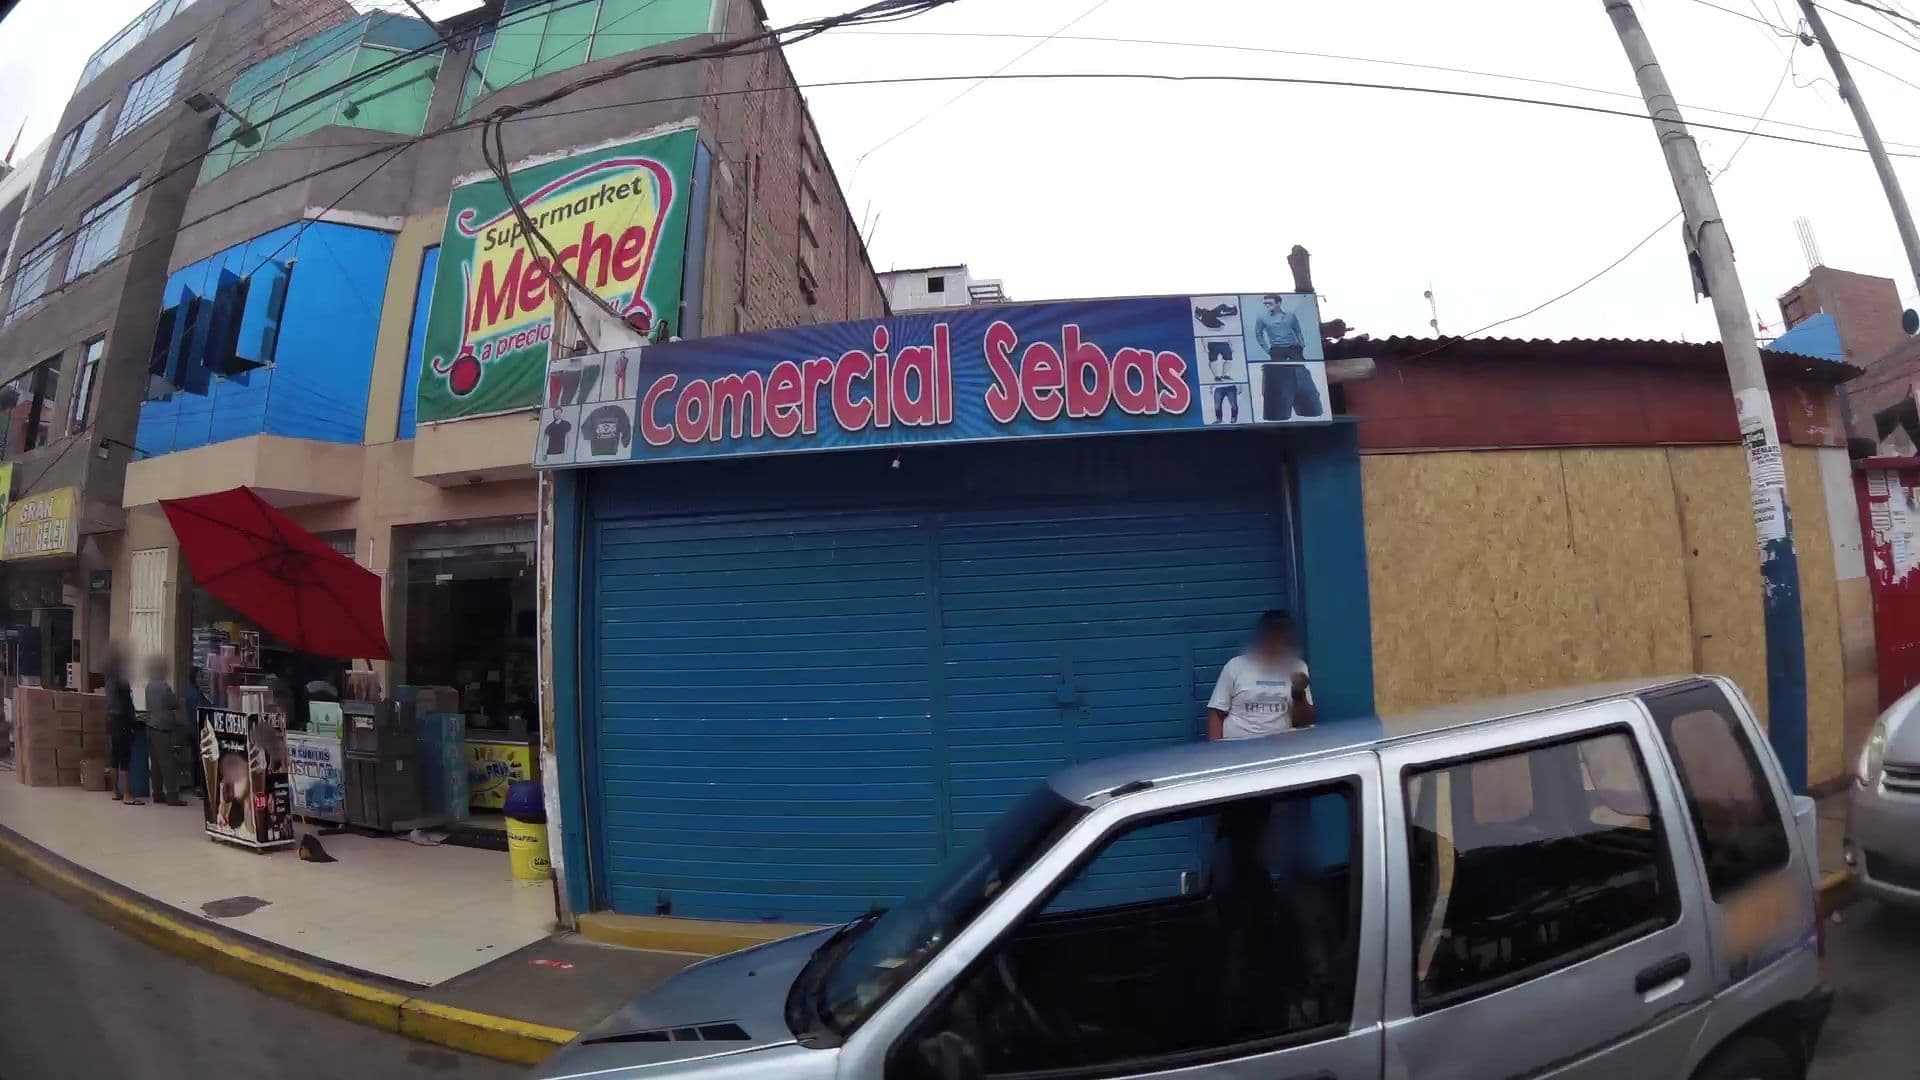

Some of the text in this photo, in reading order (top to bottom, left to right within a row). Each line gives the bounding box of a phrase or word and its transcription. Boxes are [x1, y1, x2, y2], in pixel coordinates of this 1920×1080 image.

[484, 176, 643, 251] Supermarket
[472, 221, 647, 332] Meche
[481, 344, 493, 361] a
[984, 320, 1191, 423] Sebas
[22, 497, 55, 520] GRAN
[225, 712, 248, 735] CREAM
